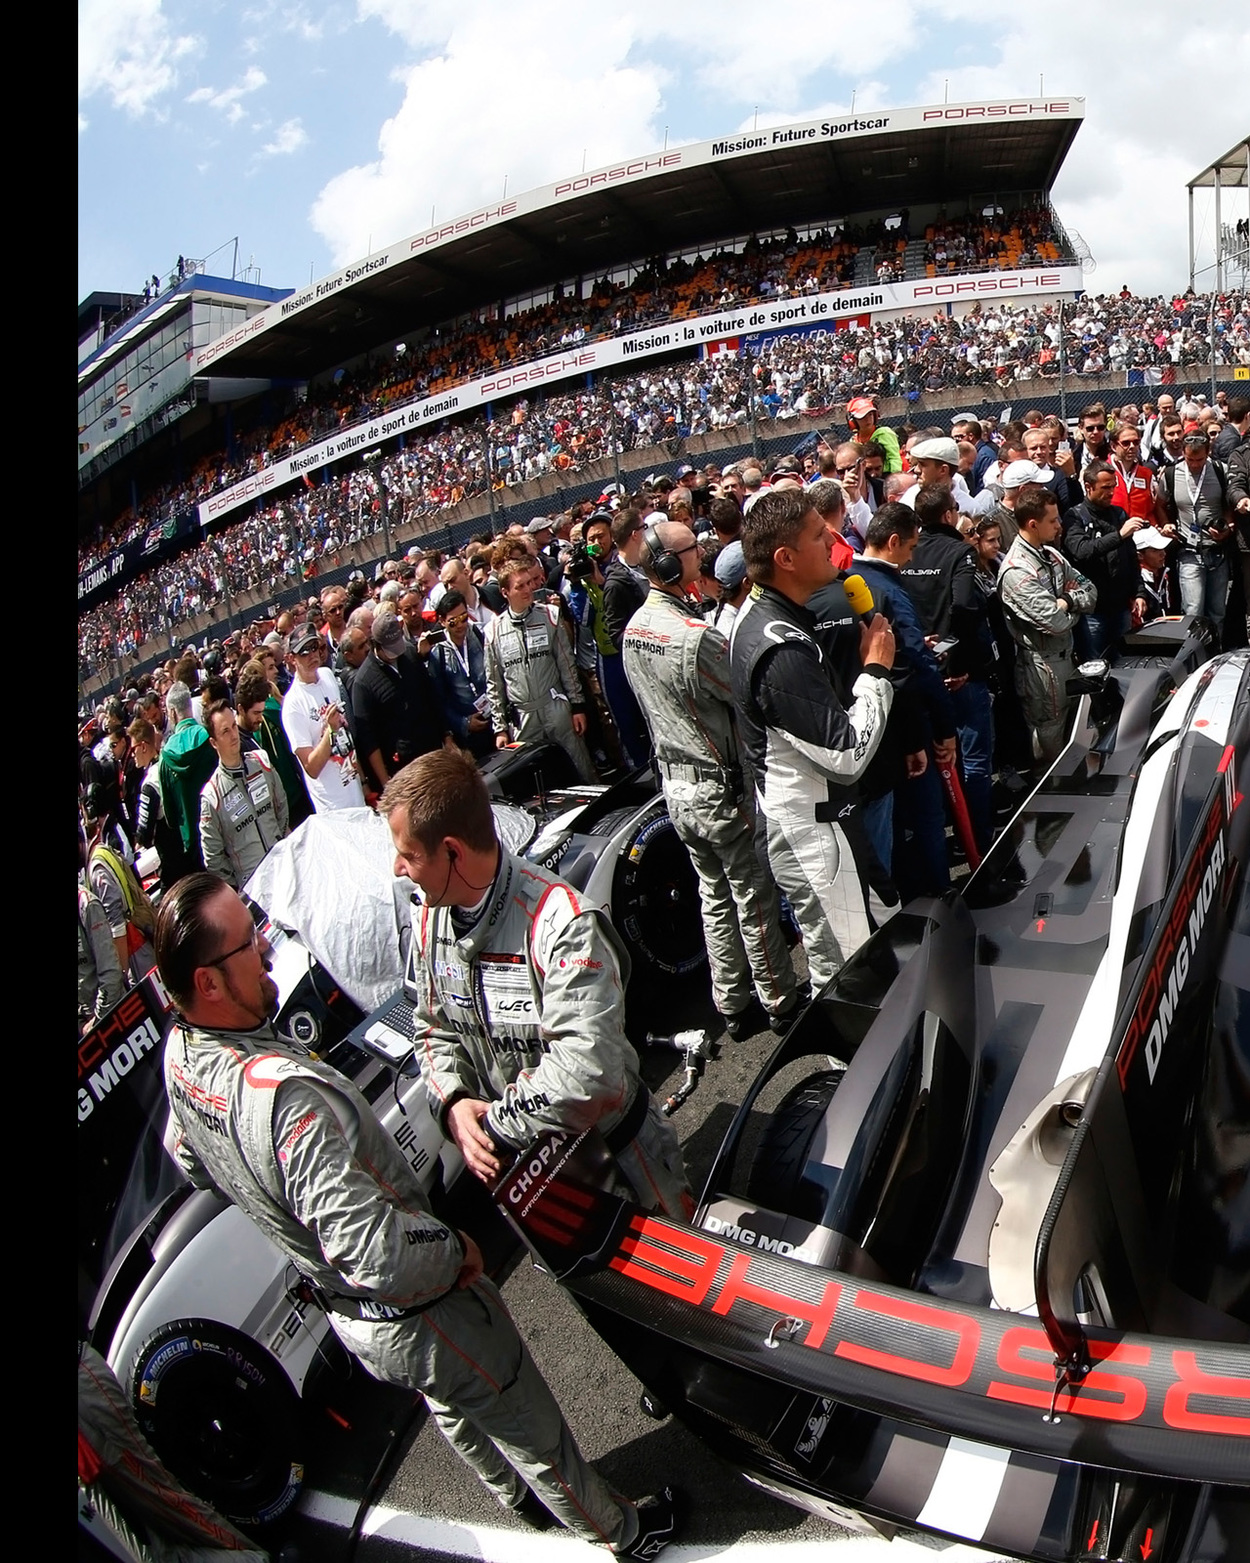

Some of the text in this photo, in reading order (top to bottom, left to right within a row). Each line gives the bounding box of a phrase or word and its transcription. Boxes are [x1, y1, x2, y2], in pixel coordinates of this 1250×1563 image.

[711, 115, 890, 156] Mission: Future Sportscar
[923, 102, 1070, 121] PORSCHE
[554, 152, 682, 197] PORSCHE
[410, 201, 517, 251] PORSCHE
[281, 253, 389, 316] Mission: Future Sportscar
[914, 274, 1061, 299] PORSCHE
[196, 316, 265, 366] PORSCHE
[622, 333, 670, 355] Mission
[683, 326, 695, 340] la
[700, 316, 745, 336] voiture
[749, 311, 766, 326] de
[770, 304, 806, 324] sport
[810, 300, 828, 315] de
[832, 293, 883, 311] demain
[480, 351, 597, 396] PORSCHE
[289, 450, 320, 475] Mission
[326, 444, 335, 459] la
[336, 431, 367, 455] voiture
[368, 424, 380, 441] de
[381, 414, 406, 438] sport
[407, 407, 420, 424] de
[423, 394, 459, 419] demain
[208, 472, 275, 516] PORSCHE
[1116, 793, 1224, 1092] PORSCHE
[1145, 828, 1226, 1086] DMG MORI
[499, 1000, 533, 1012] WEC
[88, 1016, 161, 1102] MORI
[286, 1110, 318, 1148] vodafone
[521, 1184, 547, 1218] OFFICIAL
[545, 1157, 567, 1185] TIMING
[703, 1215, 820, 1265] DMG MORI
[149, 1340, 190, 1377] MICHELIN
